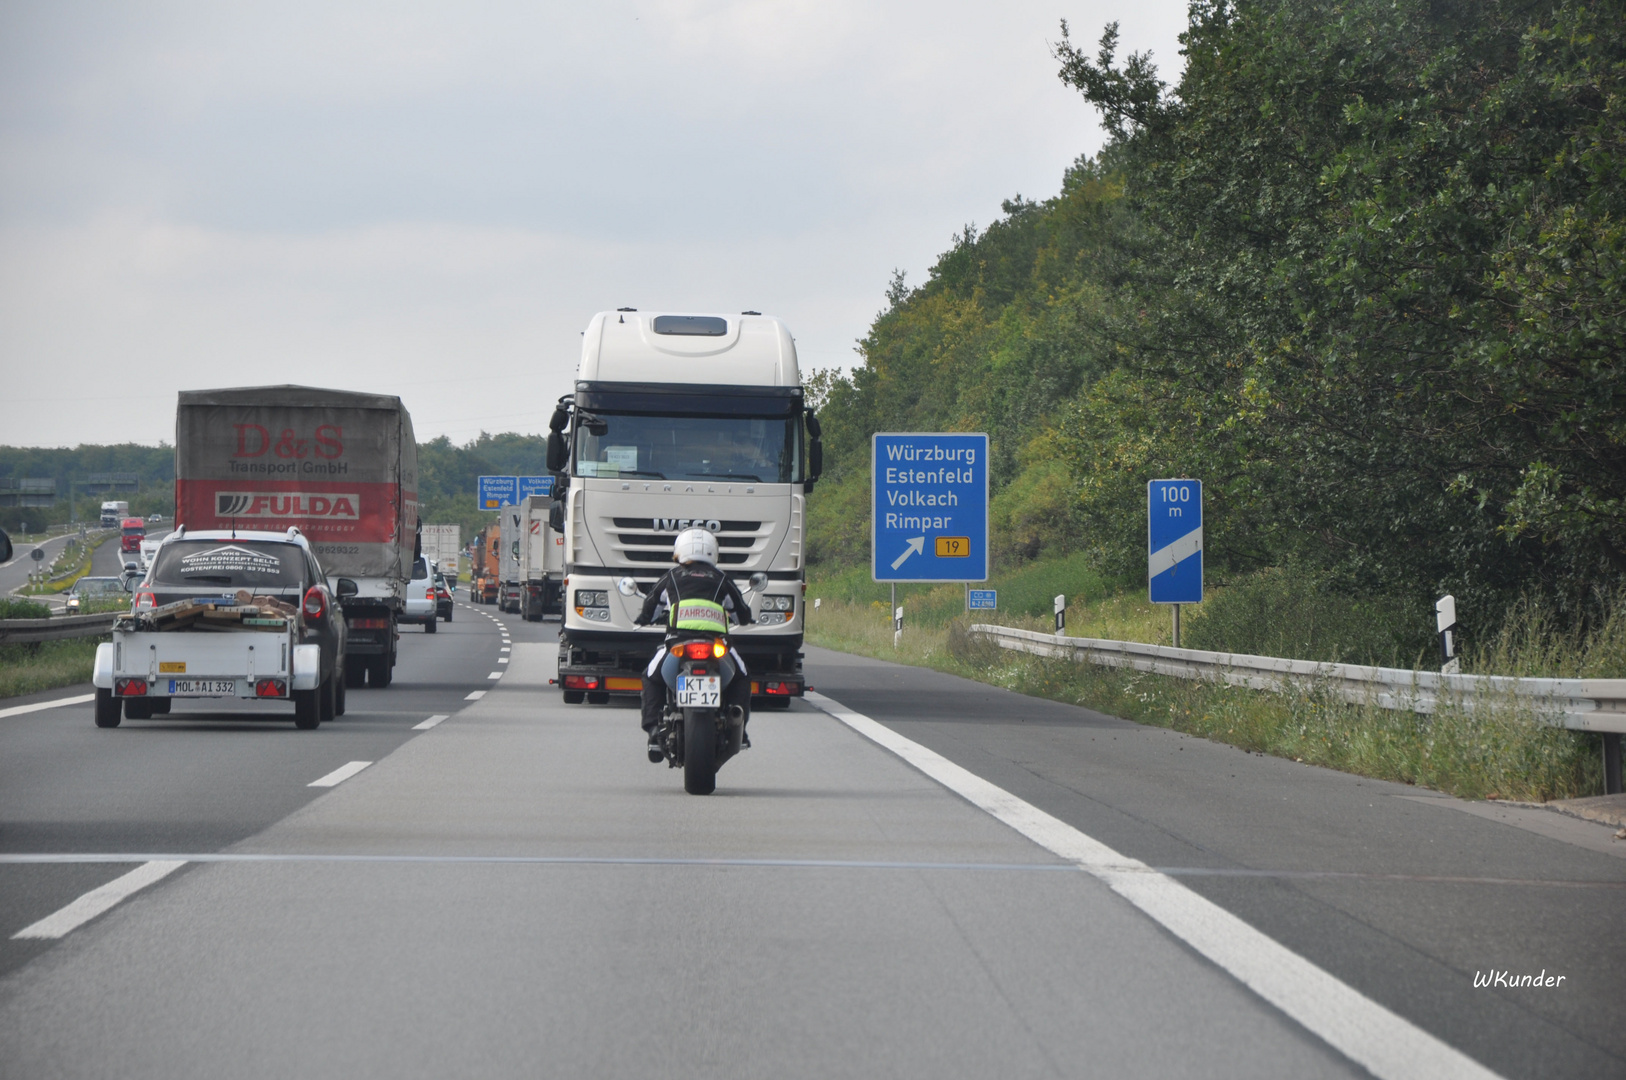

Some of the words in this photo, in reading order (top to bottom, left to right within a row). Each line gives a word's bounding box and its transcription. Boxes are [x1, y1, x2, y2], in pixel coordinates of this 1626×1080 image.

[232, 423, 344, 460] D&S
[886, 444, 976, 465] Würzburg
[229, 460, 297, 474] Transport
[303, 462, 348, 474] GmbH
[483, 478, 514, 486] Würzburg
[886, 467, 973, 484] Estenfeld
[621, 482, 755, 494] STRALIS
[1160, 486, 1190, 502] 100
[887, 490, 958, 506] Volkach
[244, 496, 356, 516] FULDA
[1169, 507, 1182, 517] m
[653, 519, 722, 532] IVECO
[886, 513, 952, 533] Rimpar
[945, 540, 960, 553] 19
[182, 556, 209, 564] WOHN
[253, 557, 280, 566] SELLE
[180, 565, 224, 573] KOSTENFREI
[175, 681, 194, 692] MOL
[201, 681, 213, 692] AI
[215, 681, 234, 692] 332
[685, 678, 704, 691] KT
[679, 693, 698, 705] UF
[701, 693, 719, 705] 17
